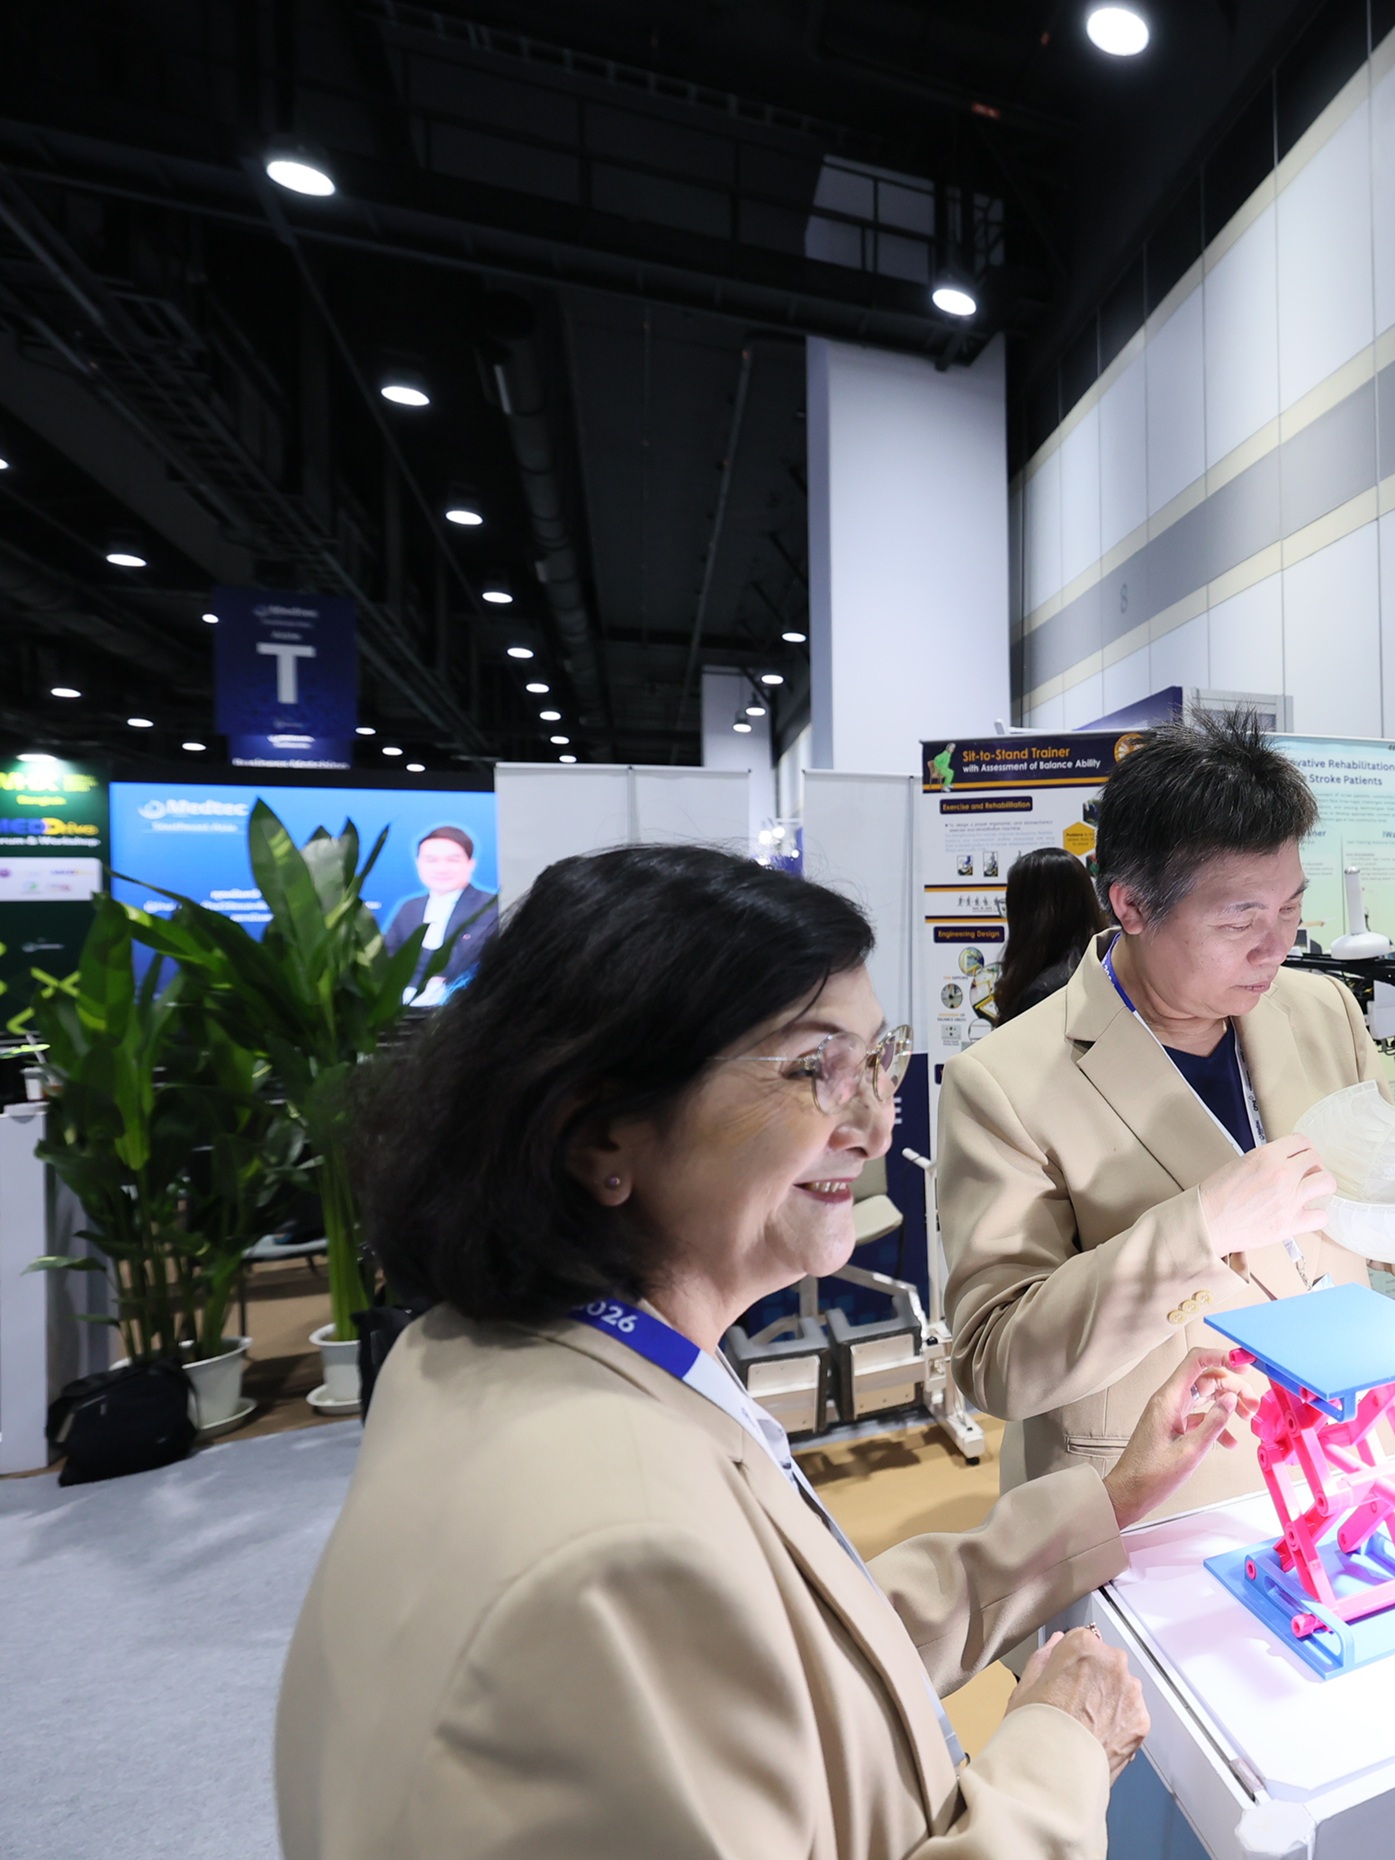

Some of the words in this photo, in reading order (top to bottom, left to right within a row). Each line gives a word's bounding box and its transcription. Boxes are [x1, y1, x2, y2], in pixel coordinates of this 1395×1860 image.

[256, 642, 317, 704] T
[963, 748, 1028, 762] Sit-to-Stand
[1032, 746, 1070, 759] Trainer
[962, 764, 979, 773] with
[981, 762, 1027, 772] Assessment
[1029, 761, 1037, 770] of
[1039, 760, 1073, 770] Balance
[1075, 758, 1101, 769] Ability
[1328, 759, 1395, 771] Rehabilitation
[1309, 774, 1341, 784] Stroke
[1344, 775, 1383, 786] Patients
[942, 803, 969, 812] Exercise
[971, 803, 983, 811] and
[985, 801, 1031, 810] Rehabilitation
[937, 930, 975, 939] Engineering
[977, 929, 1000, 938] Design
[574, 1301, 638, 1333] 026
